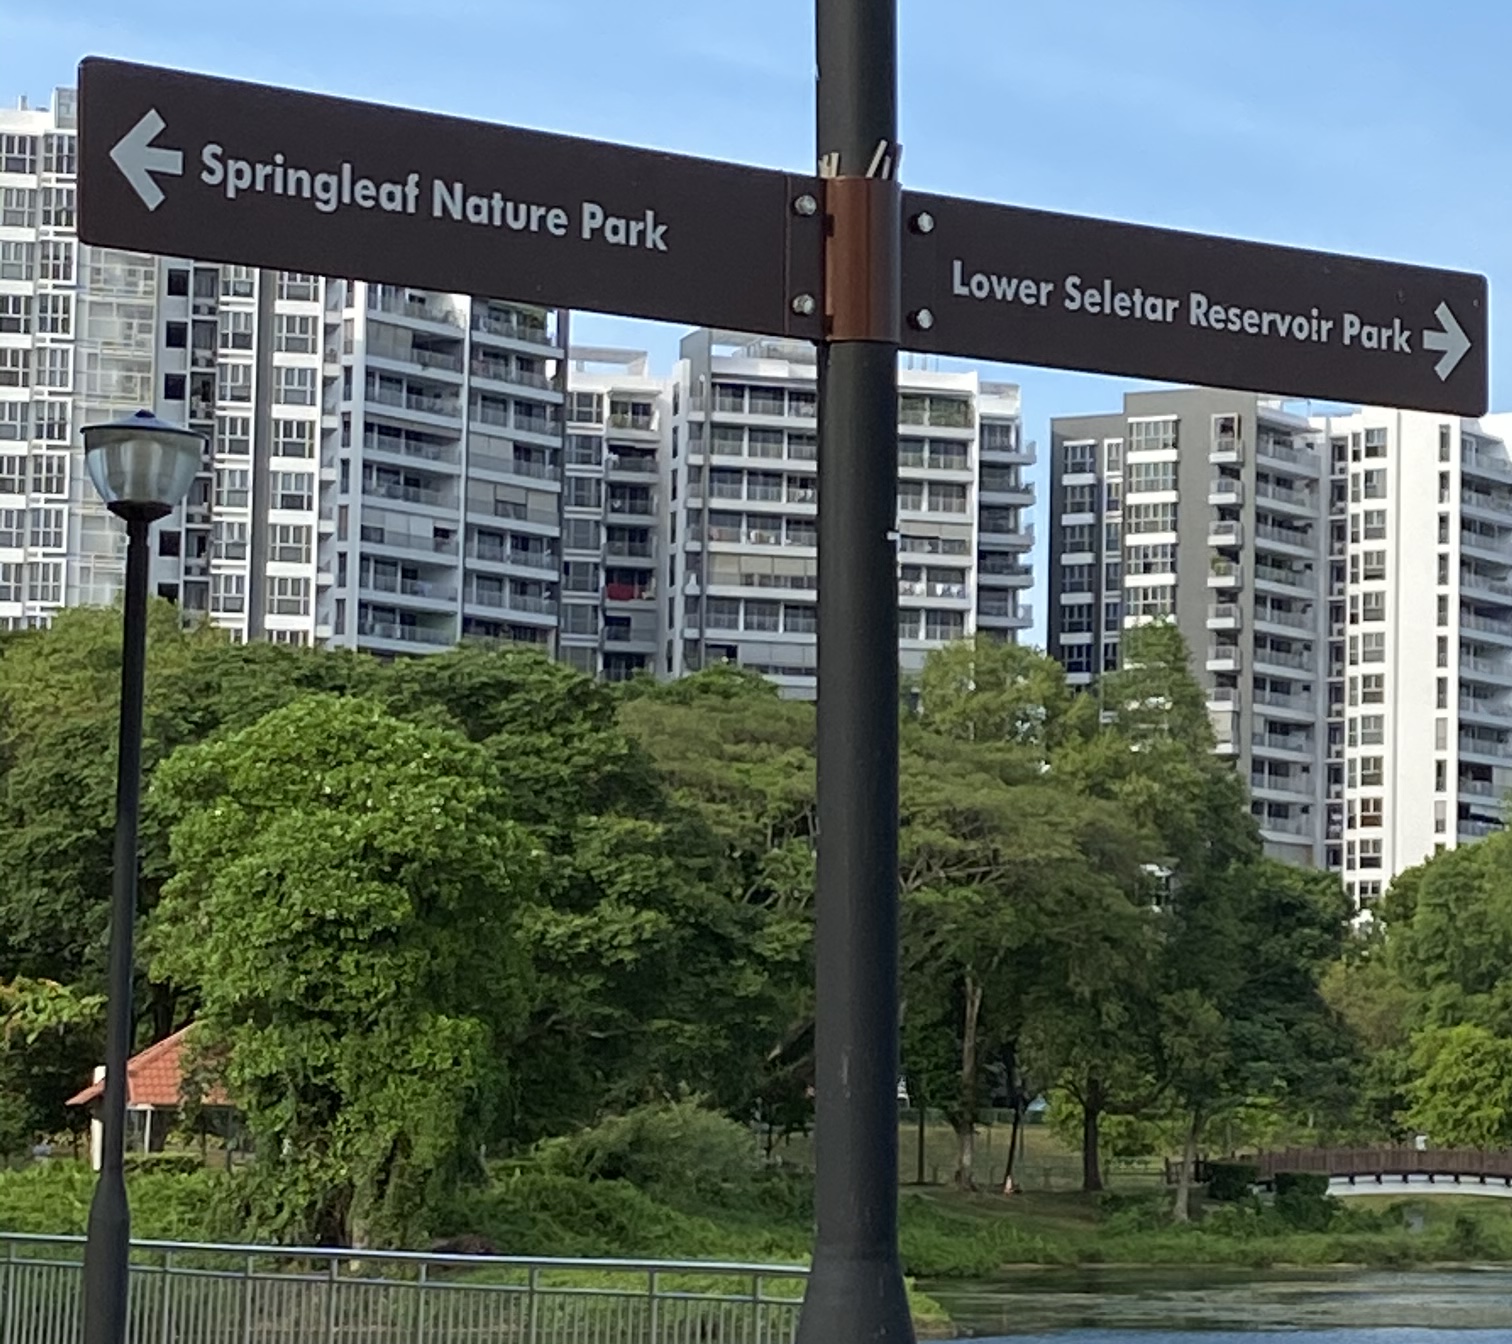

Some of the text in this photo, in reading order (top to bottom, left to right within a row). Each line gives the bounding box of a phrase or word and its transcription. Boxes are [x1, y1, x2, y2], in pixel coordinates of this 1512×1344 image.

[200, 144, 667, 251] Springleaf Nature Park
[953, 259, 1412, 354] Lower Seletar Reservoir Park
